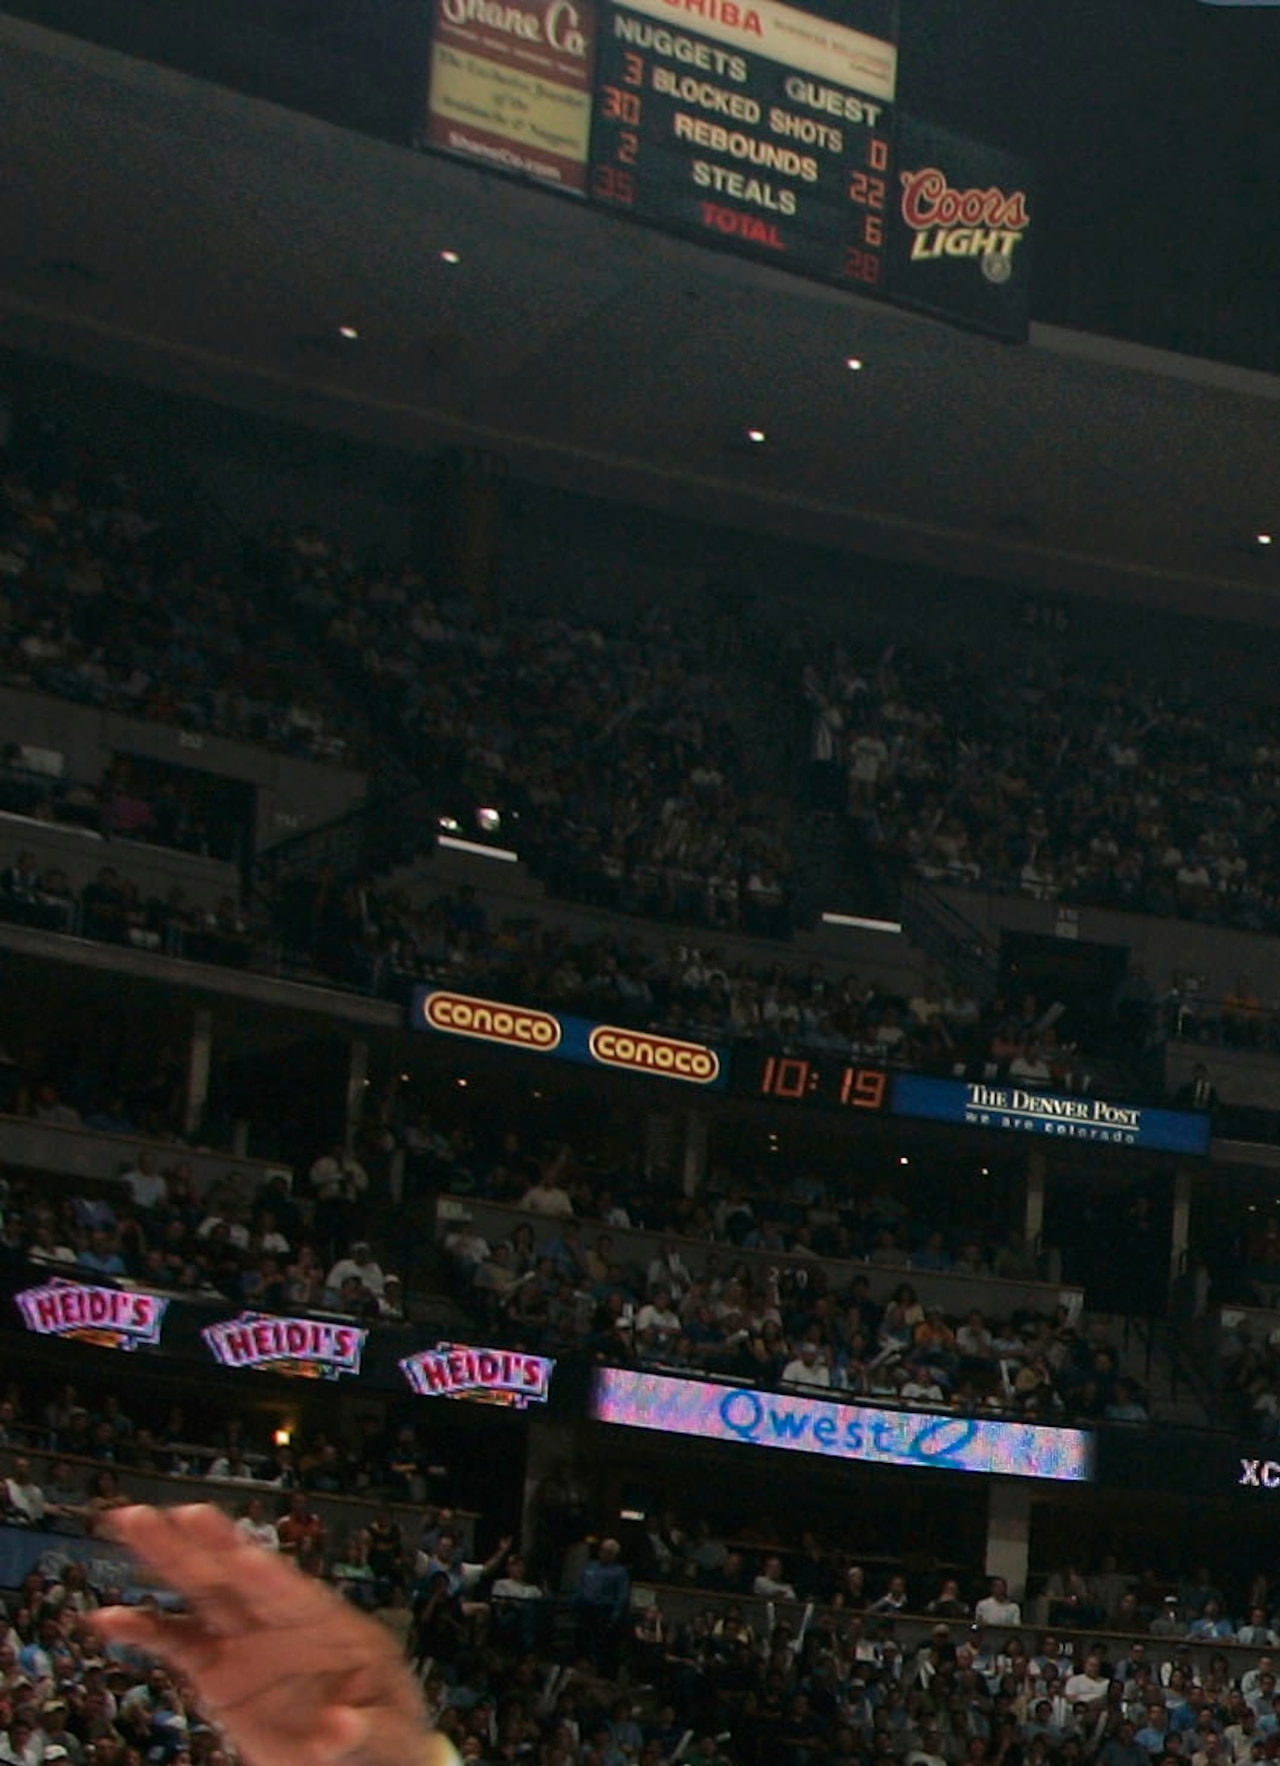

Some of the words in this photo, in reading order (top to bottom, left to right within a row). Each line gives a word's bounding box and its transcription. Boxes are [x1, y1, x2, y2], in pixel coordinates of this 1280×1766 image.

[614, 14, 748, 83] NUGGETS
[785, 76, 882, 127] GUEST
[624, 52, 644, 86] 3
[601, 85, 641, 126] 30
[652, 66, 762, 125] BLOCKED
[769, 106, 843, 153] SHOTS
[618, 131, 640, 164] 2
[672, 111, 818, 182] REBOUNDS
[869, 138, 888, 171] 0
[692, 159, 797, 216] STEALS
[849, 170, 886, 209] 22
[900, 167, 1030, 230] Coors
[700, 201, 786, 251] TOTAL
[865, 215, 884, 247] 6
[911, 228, 1022, 261] LIGHT
[966, 1083, 1008, 1107] THE
[1012, 1090, 1089, 1118] DENVER
[1093, 1101, 1141, 1125] POST
[768, 1265, 808, 1287] 20
[36, 1289, 152, 1327] HEIDI'S
[226, 1322, 355, 1362] HEIDI'S
[421, 1351, 541, 1389] HEIDI'S
[719, 1389, 894, 1453] Qwest
